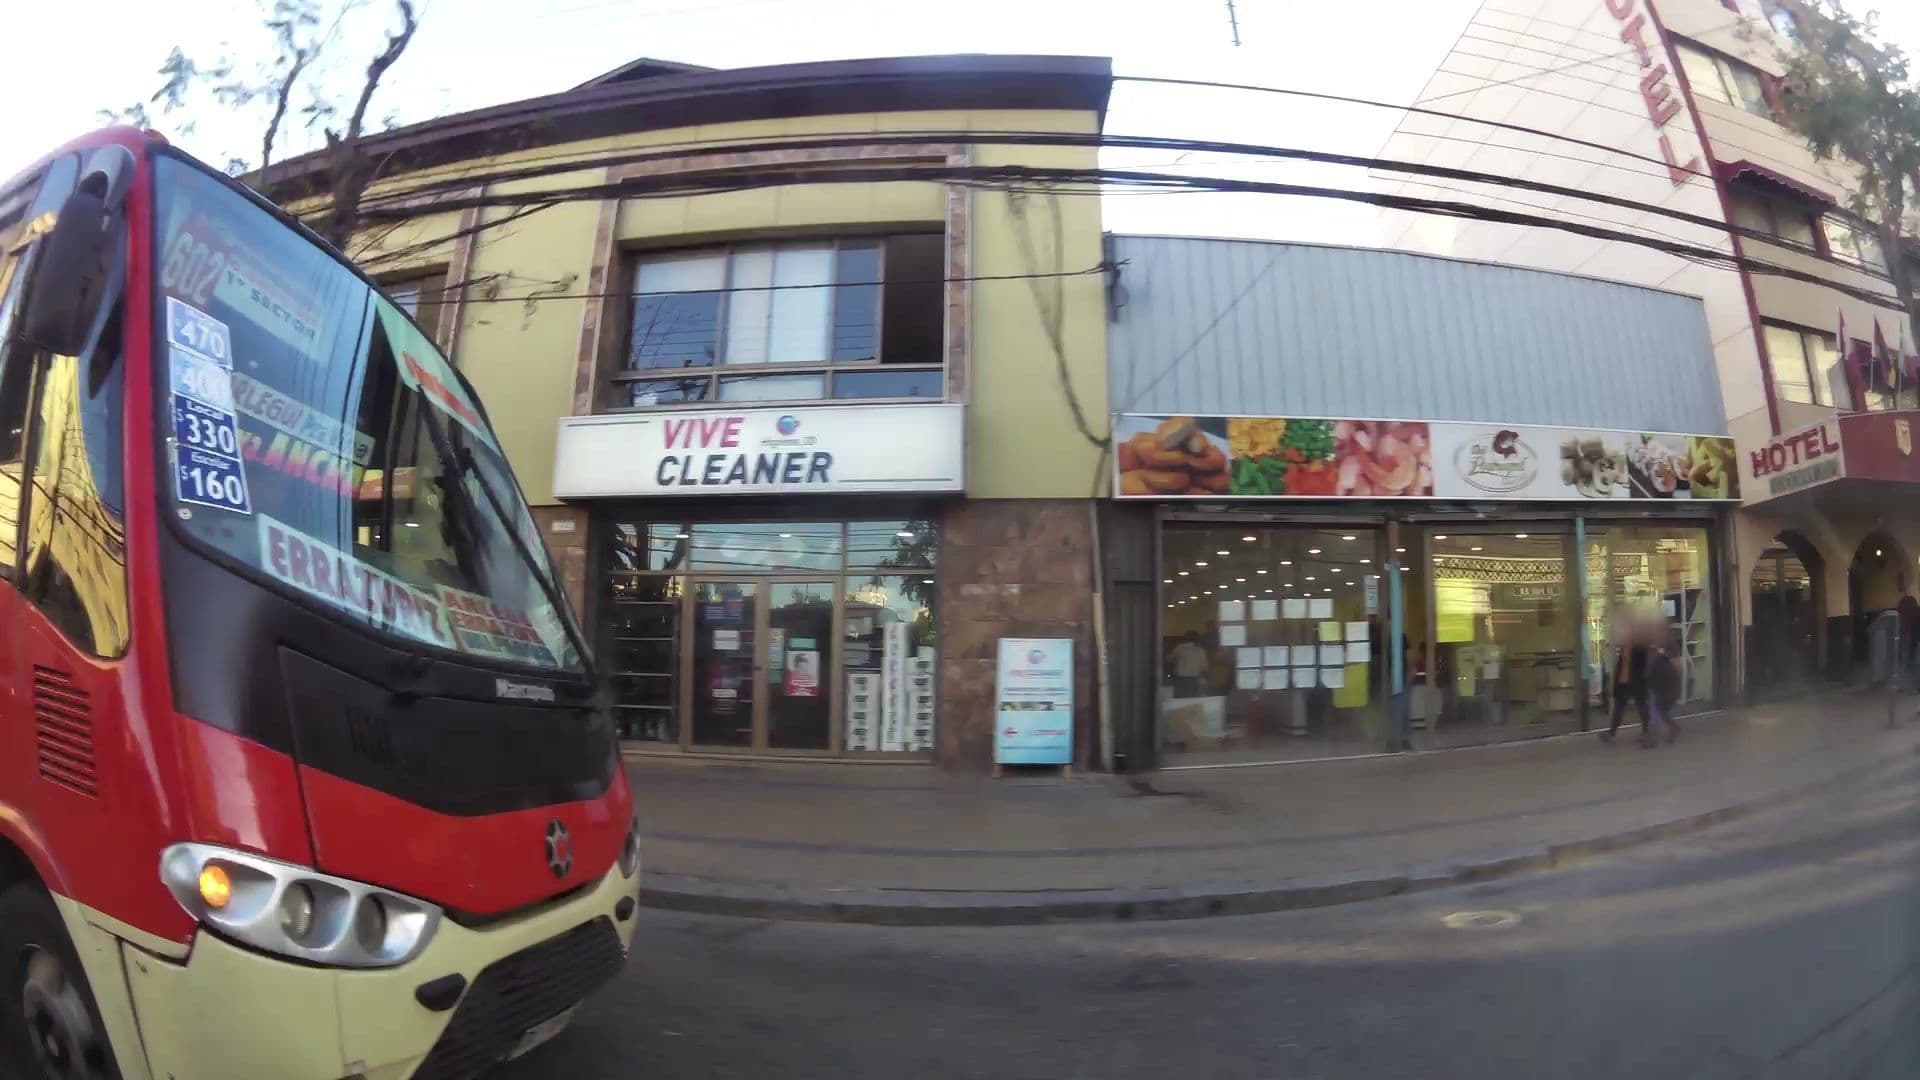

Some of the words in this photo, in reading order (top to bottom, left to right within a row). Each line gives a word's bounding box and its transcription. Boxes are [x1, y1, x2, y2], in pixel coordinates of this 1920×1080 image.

[162, 232, 225, 305] 602
[664, 416, 745, 449] VIVE
[1750, 424, 1840, 478] HOTEL
[655, 451, 833, 487] CLEANER
